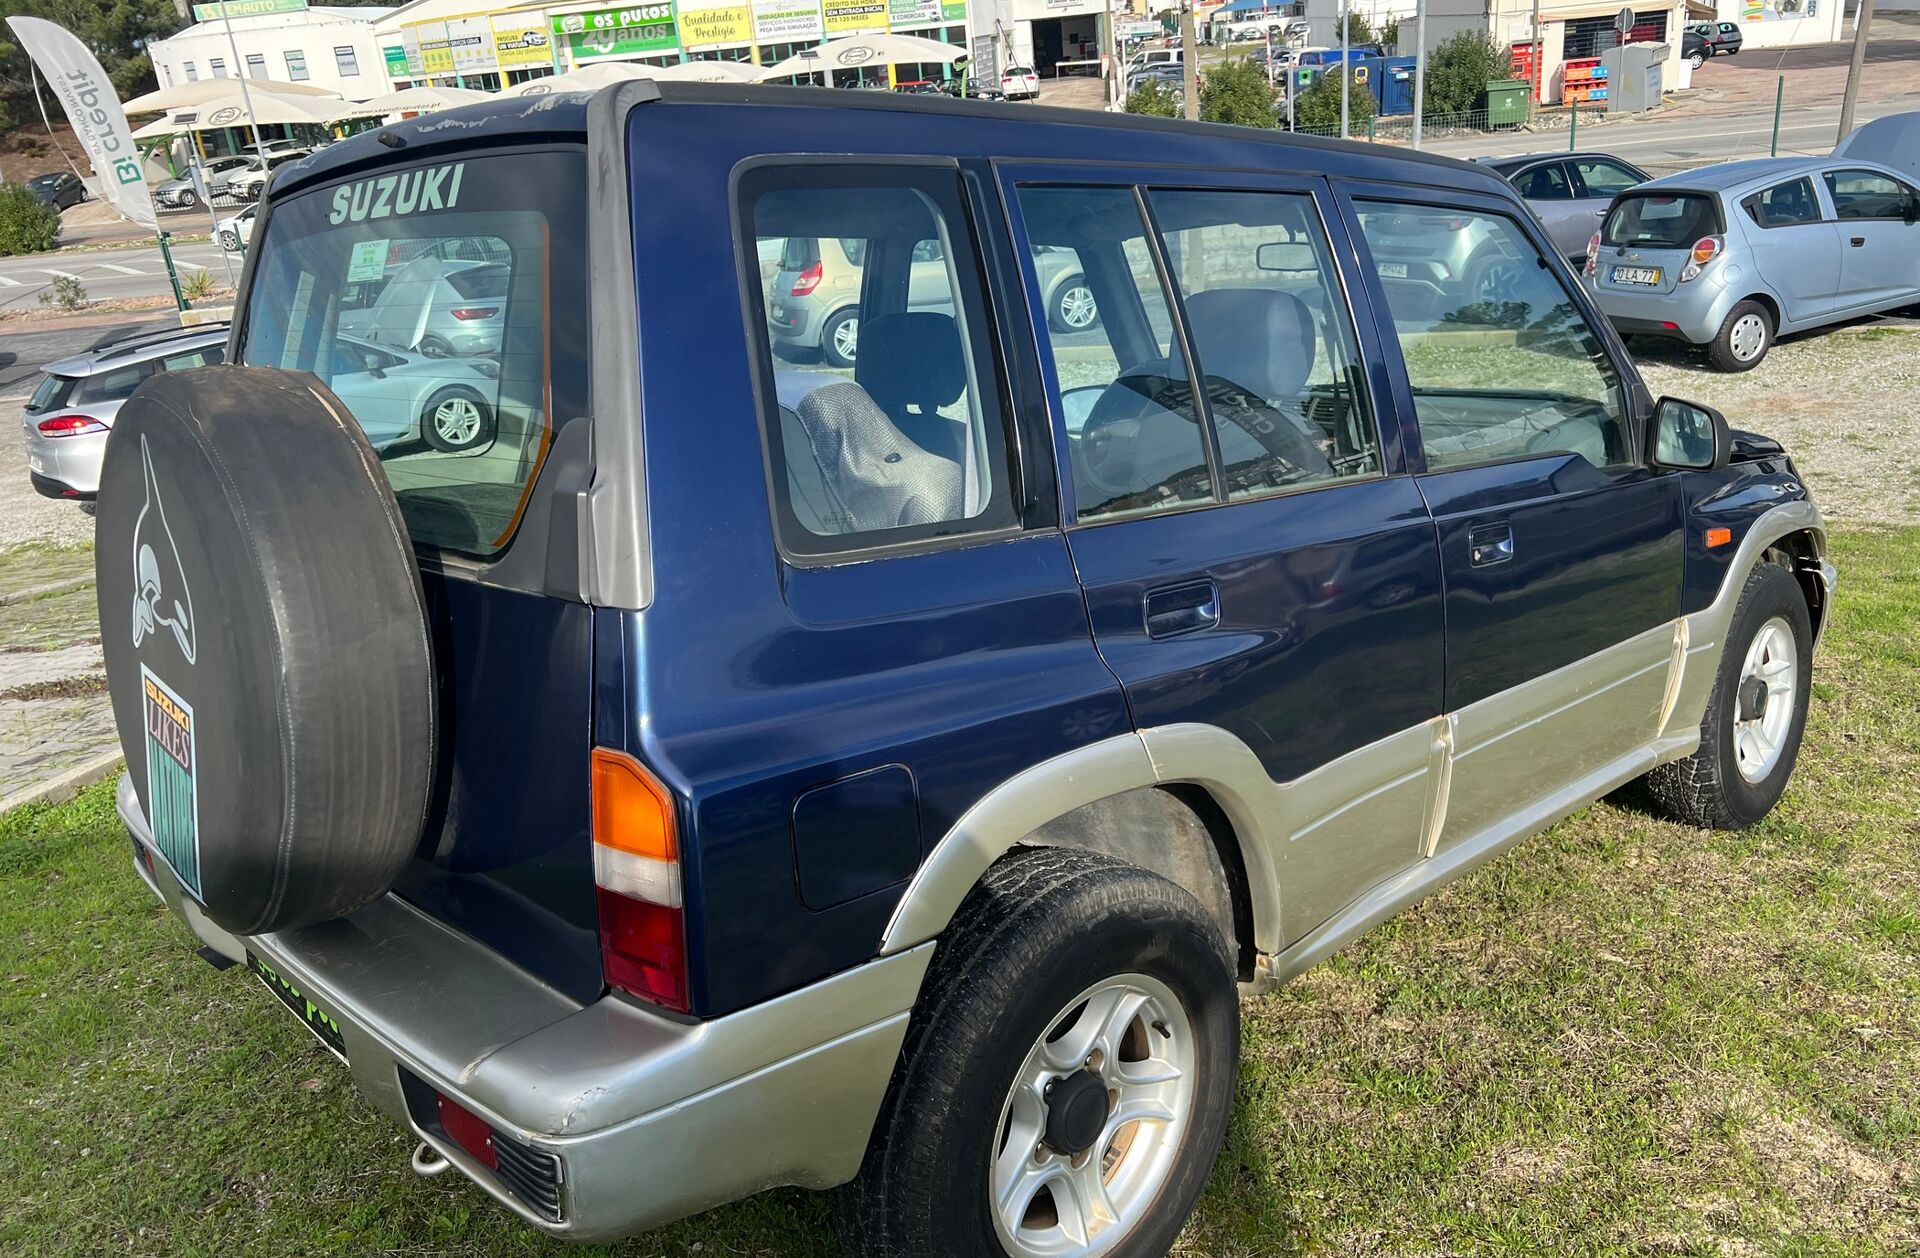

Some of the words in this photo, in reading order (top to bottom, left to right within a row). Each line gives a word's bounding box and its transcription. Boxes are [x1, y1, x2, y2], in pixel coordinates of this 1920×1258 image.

[593, 14, 614, 28] os
[620, 5, 669, 27] putos
[617, 24, 667, 41] anos
[683, 11, 735, 27] Qualidade
[737, 13, 743, 21] e
[329, 163, 465, 225] SUZUKI
[145, 678, 190, 733] SUZUKI
[149, 698, 190, 769] LIKES
